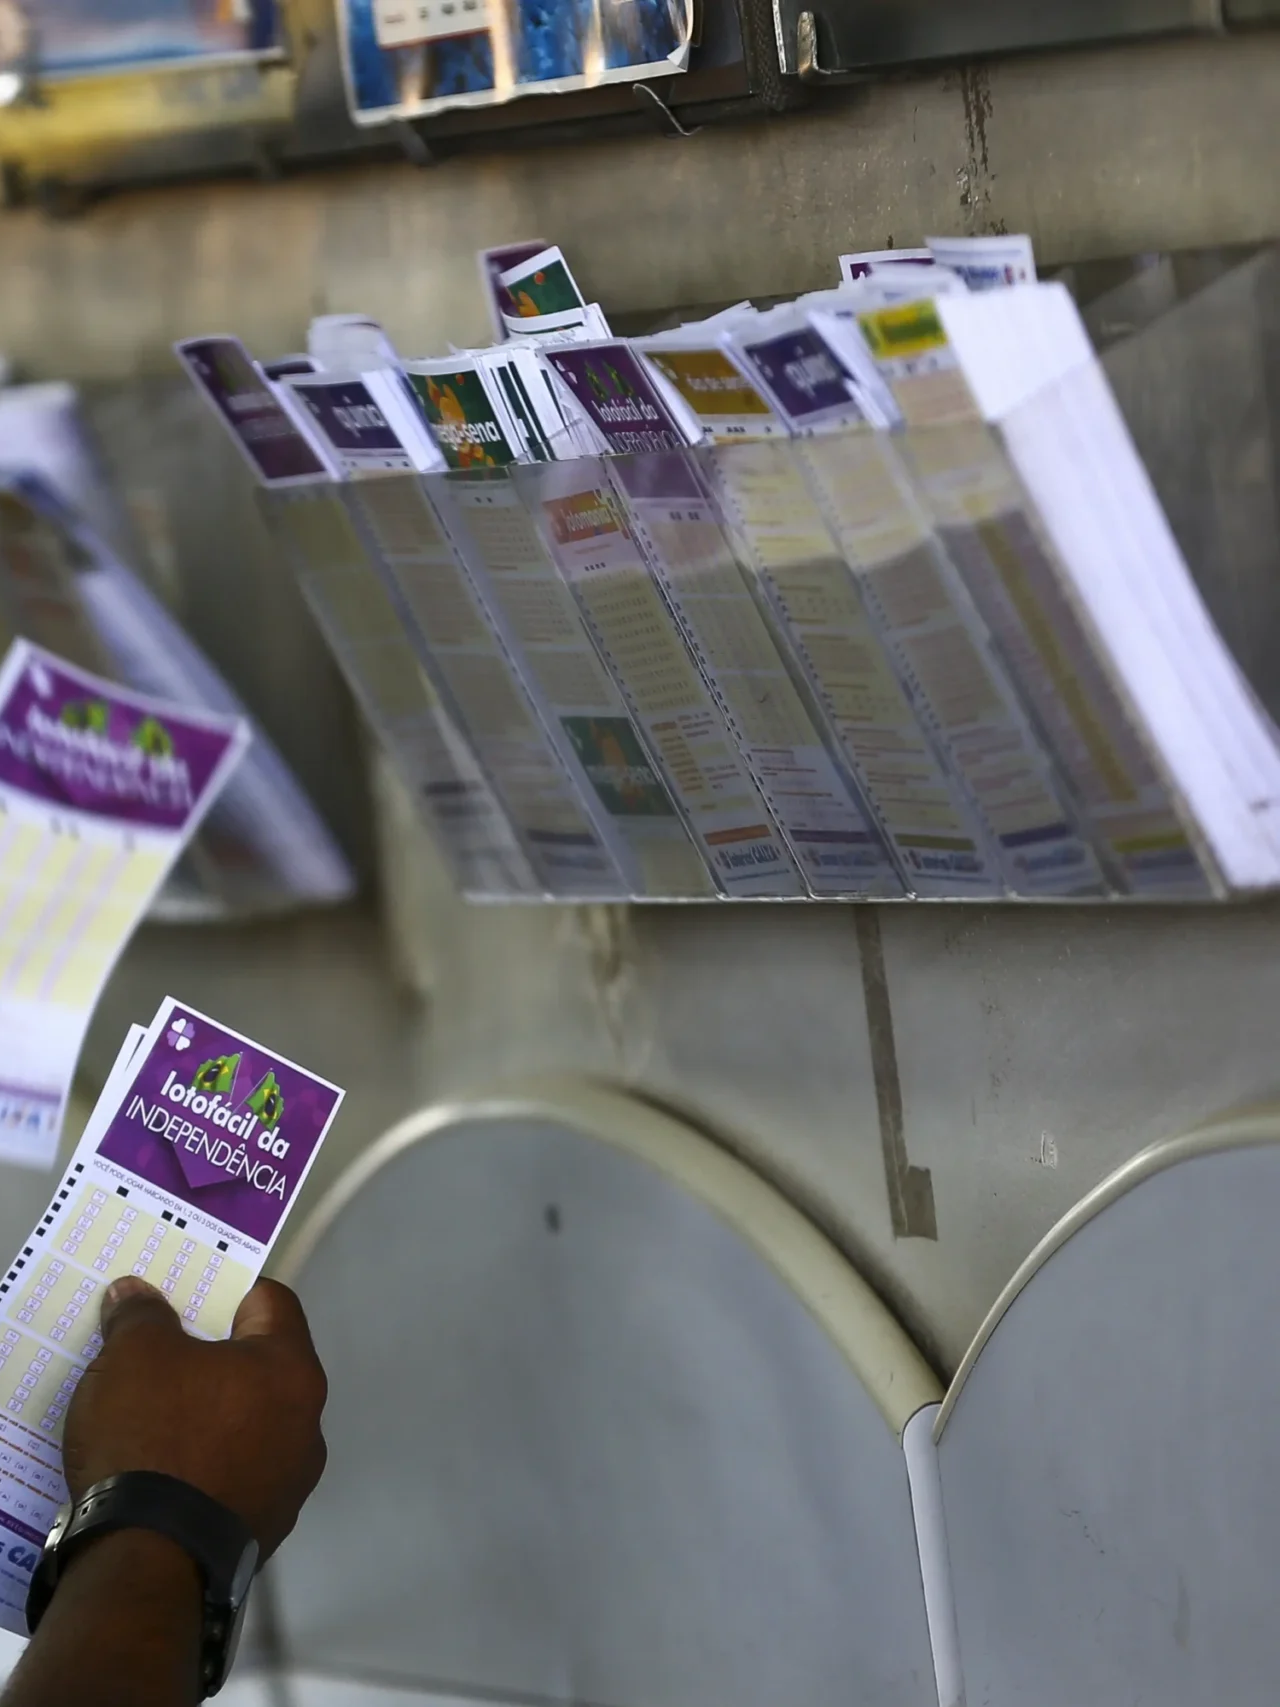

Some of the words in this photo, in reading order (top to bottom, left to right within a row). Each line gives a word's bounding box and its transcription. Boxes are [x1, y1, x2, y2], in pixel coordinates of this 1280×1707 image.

[640, 397, 660, 421] da
[125, 1094, 288, 1201] INDEPENDÊNCIA
[160, 1070, 259, 1141] lotofácil
[257, 1126, 291, 1160] da
